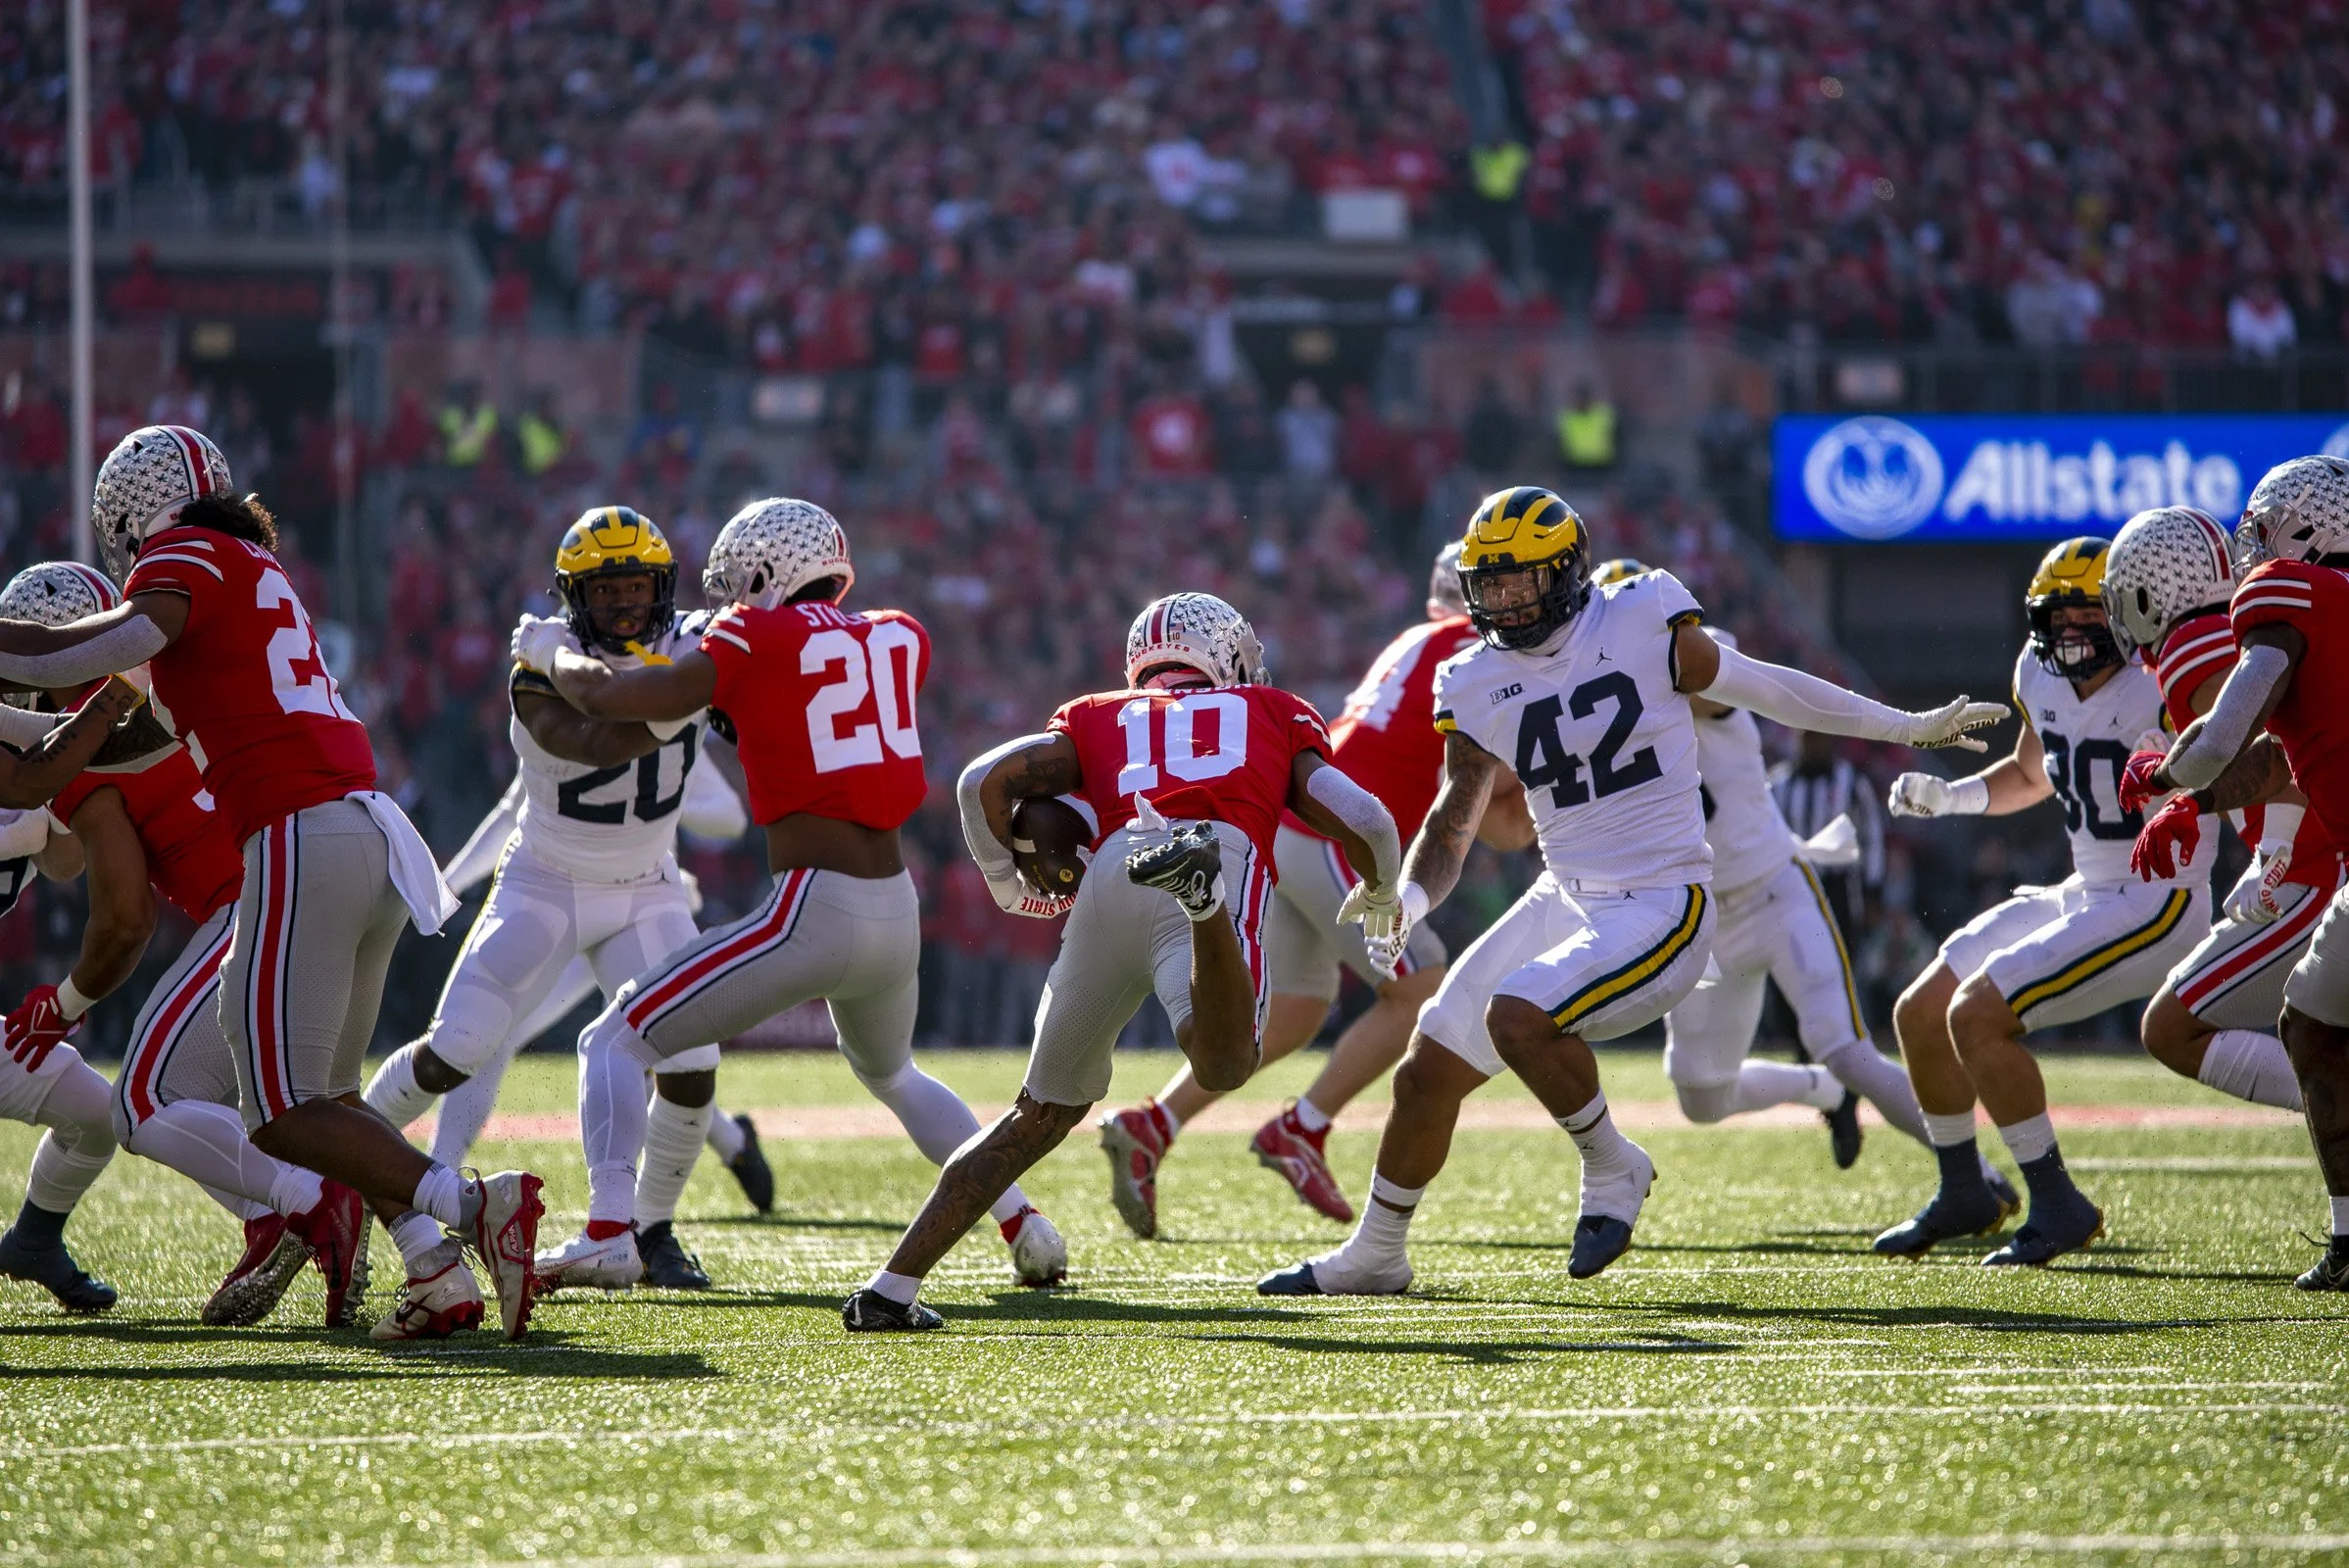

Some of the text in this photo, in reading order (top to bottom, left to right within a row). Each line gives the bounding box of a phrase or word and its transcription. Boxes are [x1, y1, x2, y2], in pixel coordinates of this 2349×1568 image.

[1942, 439, 2242, 522] Allstate
[1130, 642, 1191, 664] BUCKEYES
[1171, 631, 1182, 641] 10
[799, 619, 922, 774] 20
[1116, 692, 1248, 798] 10
[1515, 670, 1664, 809] 42
[1019, 896, 1056, 917] STATE
[508, 1224, 519, 1253] ALPHA
